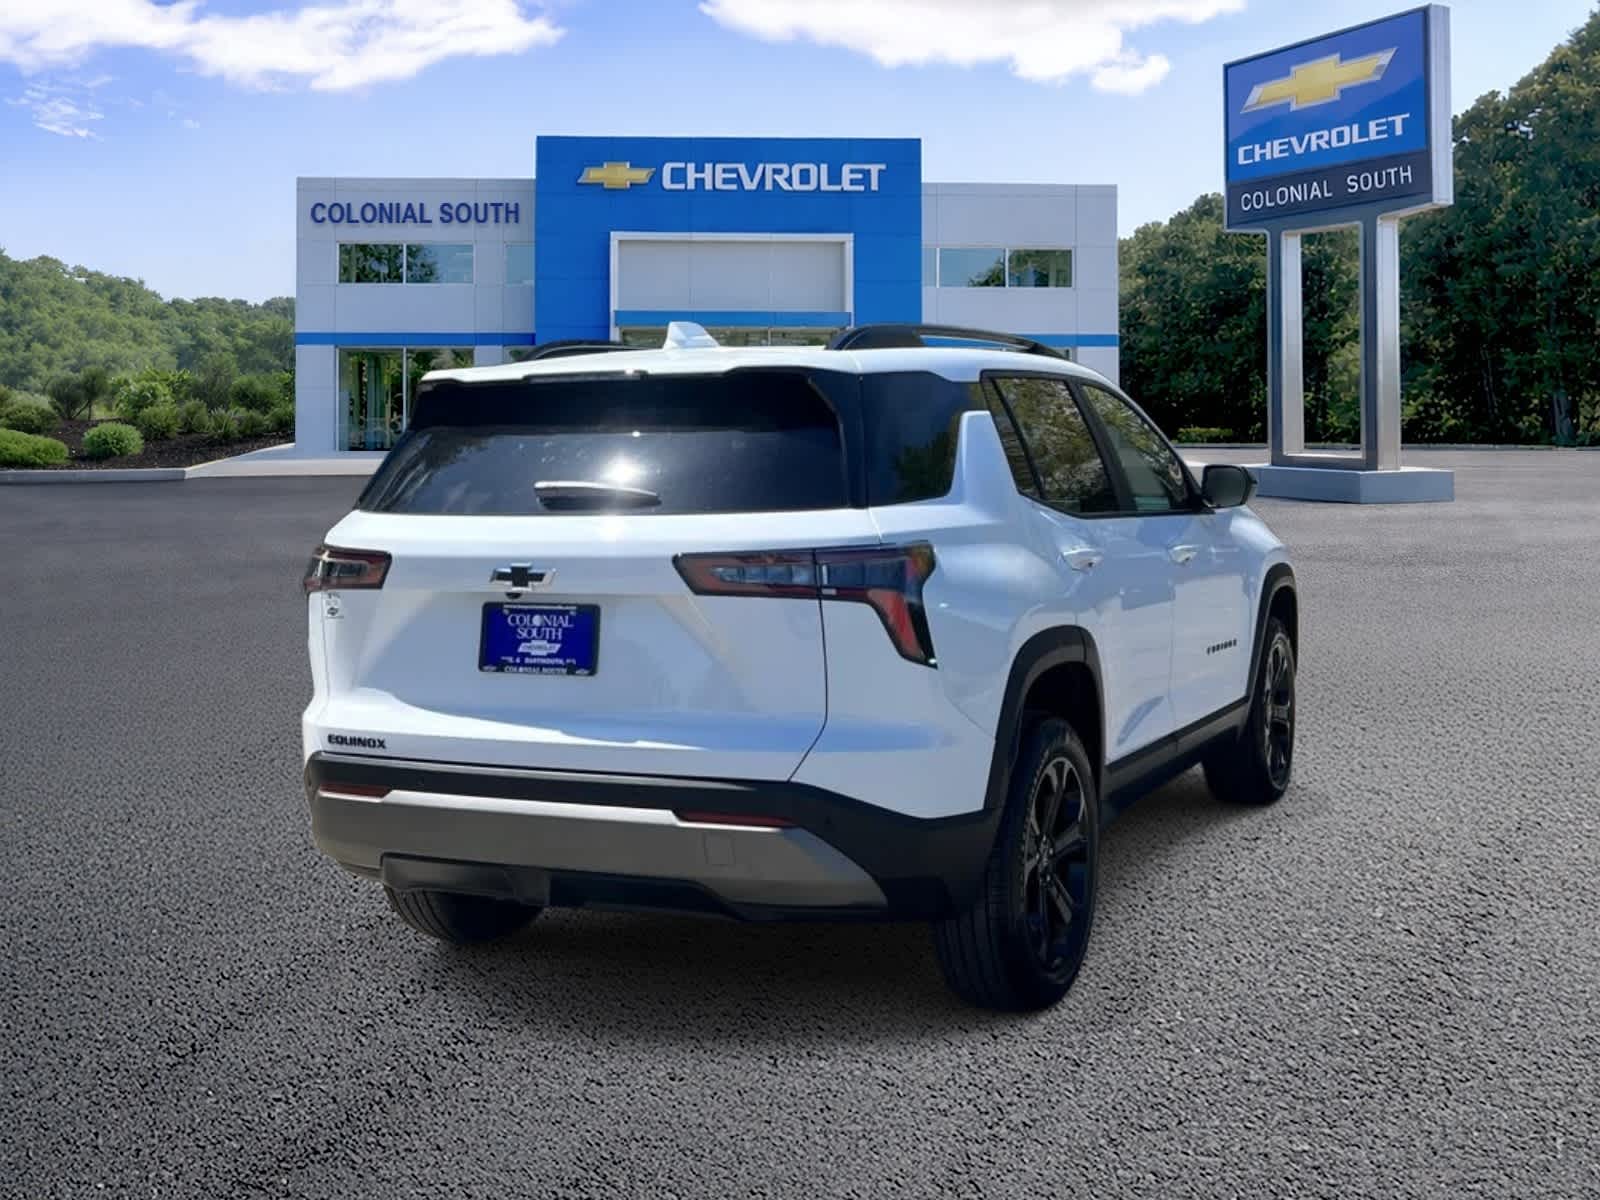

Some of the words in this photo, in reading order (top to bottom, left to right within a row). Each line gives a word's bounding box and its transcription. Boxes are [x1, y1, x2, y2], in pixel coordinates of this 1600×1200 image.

[1237, 113, 1410, 165] CHEVROLET
[662, 161, 886, 193] CHEVROLET
[1240, 179, 1333, 211] COLONIAL
[1346, 165, 1412, 193] SOUTH
[310, 202, 432, 224] COLONIAL
[439, 202, 519, 224] SOUTH
[507, 613, 574, 628] COLONIAL
[516, 627, 563, 641] SOUTH
[327, 733, 387, 749] EQUINOX
